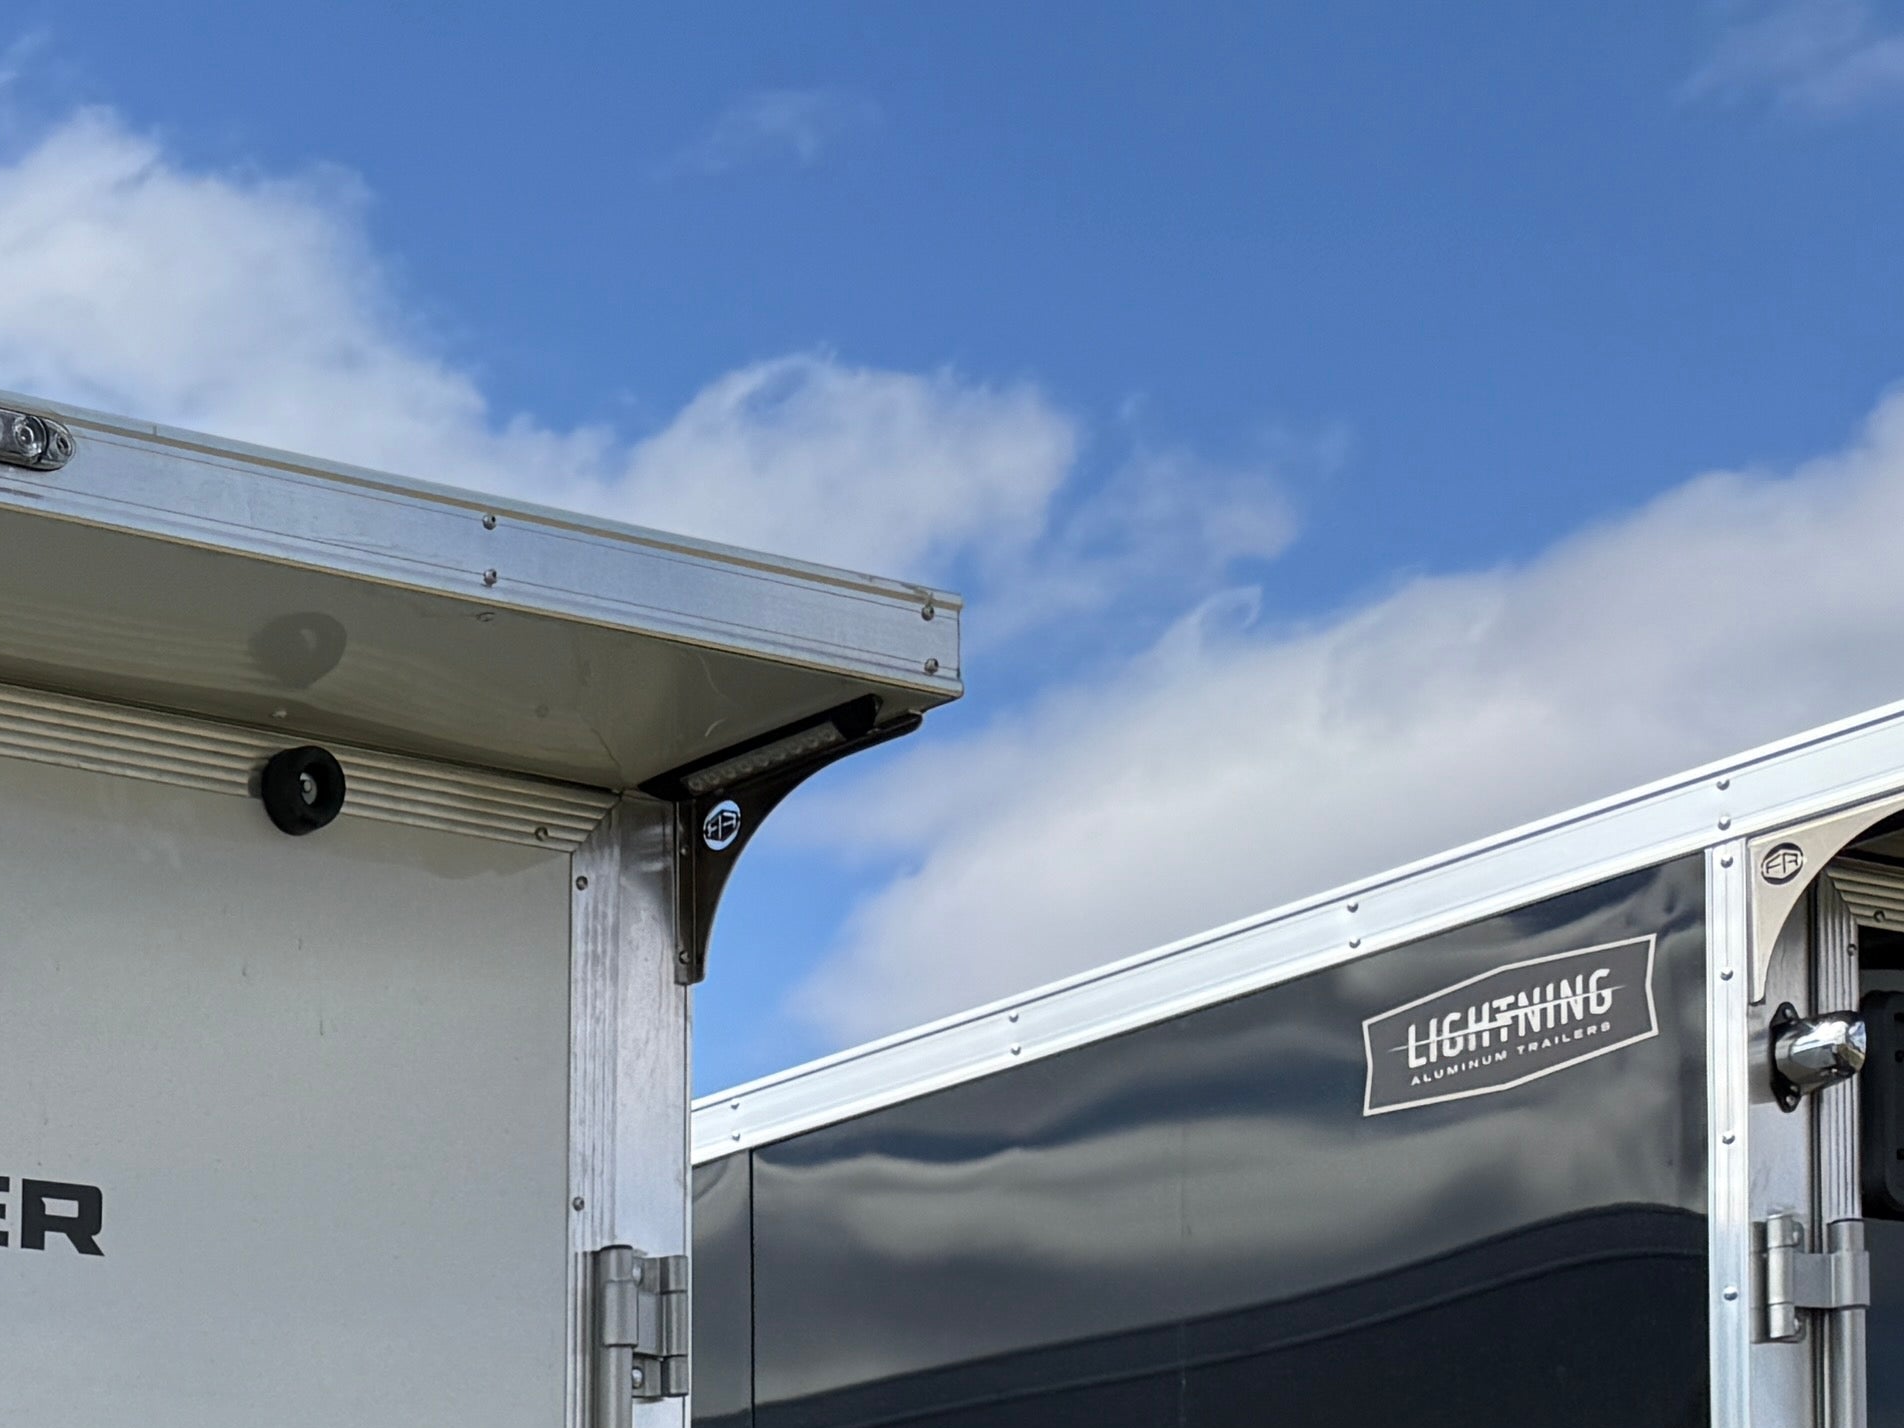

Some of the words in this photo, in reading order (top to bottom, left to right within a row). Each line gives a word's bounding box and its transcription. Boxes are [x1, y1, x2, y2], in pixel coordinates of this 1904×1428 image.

[1407, 968, 1613, 1069] LIGHTNING
[1410, 1050, 1508, 1086] ALUMINUM
[1517, 1020, 1612, 1056] TRAILERS
